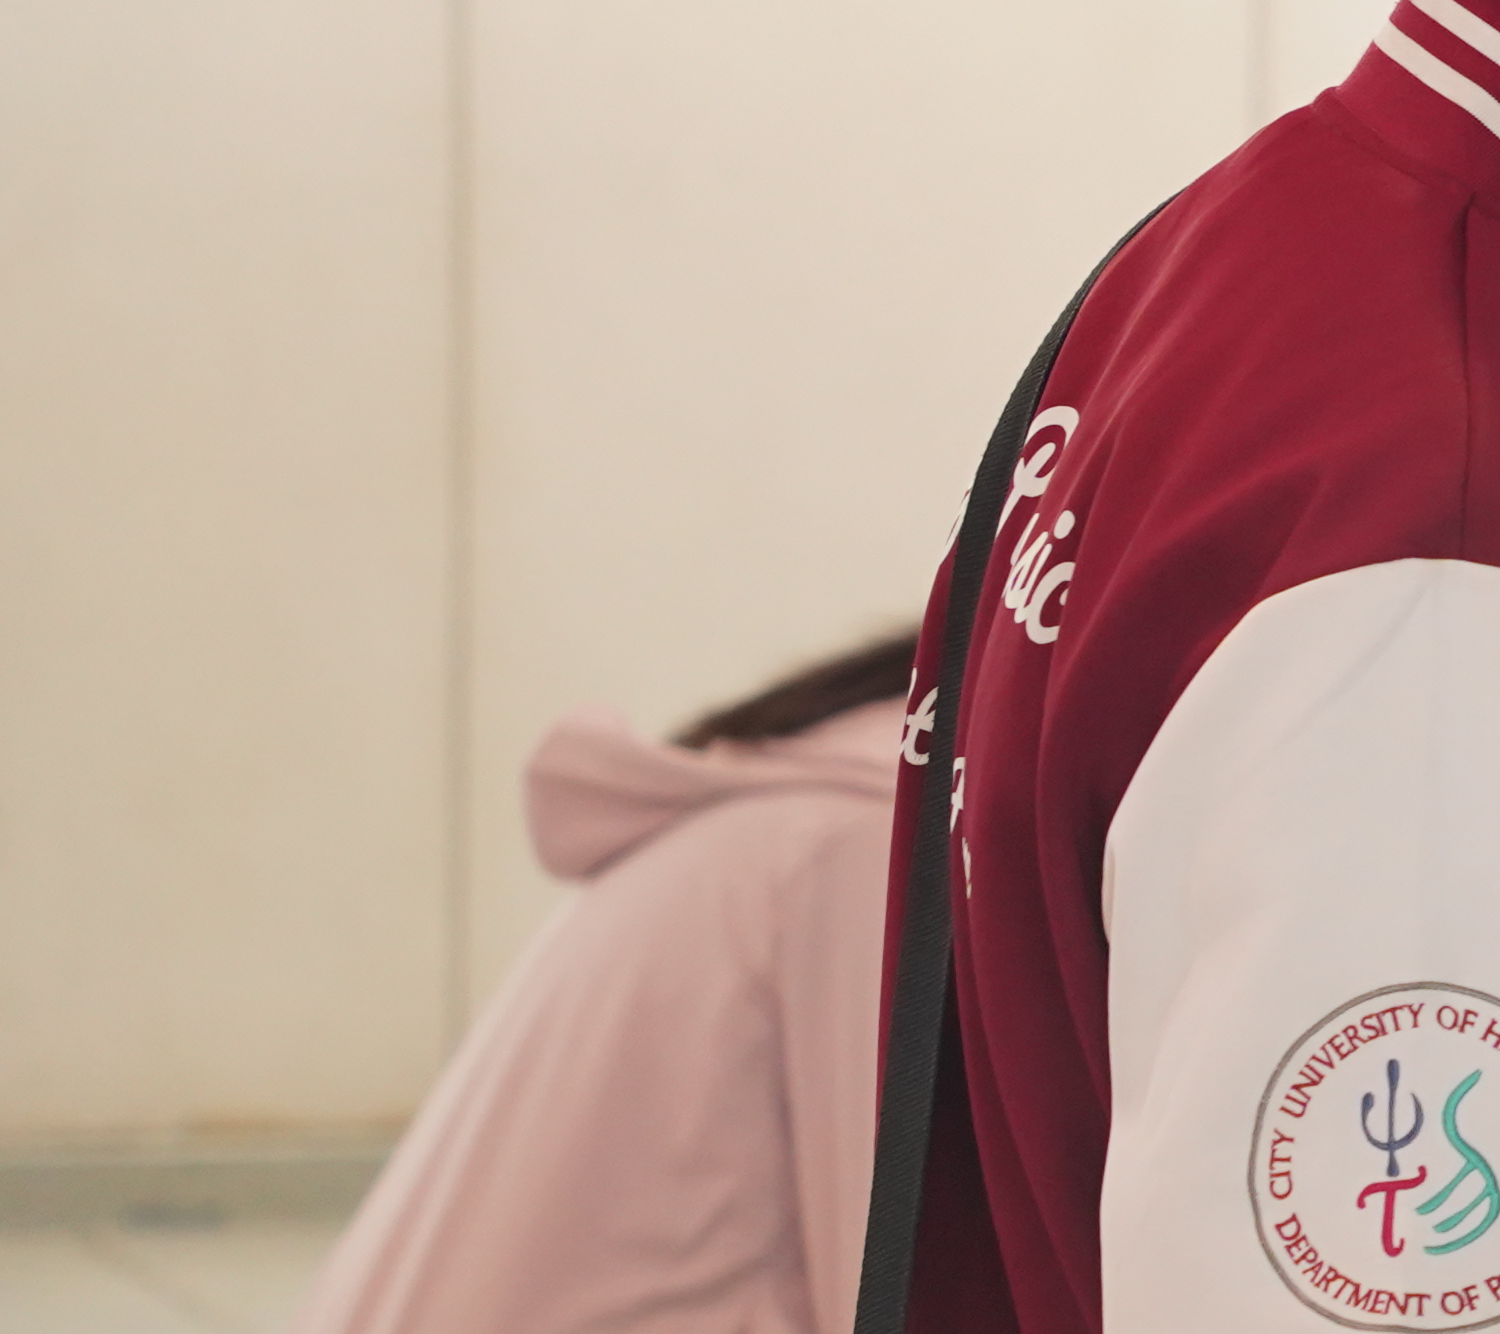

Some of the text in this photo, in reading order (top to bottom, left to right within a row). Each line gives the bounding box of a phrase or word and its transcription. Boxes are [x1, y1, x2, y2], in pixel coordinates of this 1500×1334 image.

[1280, 1003, 1424, 1118] UNIVERSITY
[1437, 1006, 1478, 1033] OF
[1269, 1130, 1294, 1199] CITY
[1275, 1213, 1430, 1317] DEPARTMENT
[1442, 1287, 1480, 1315] OF
